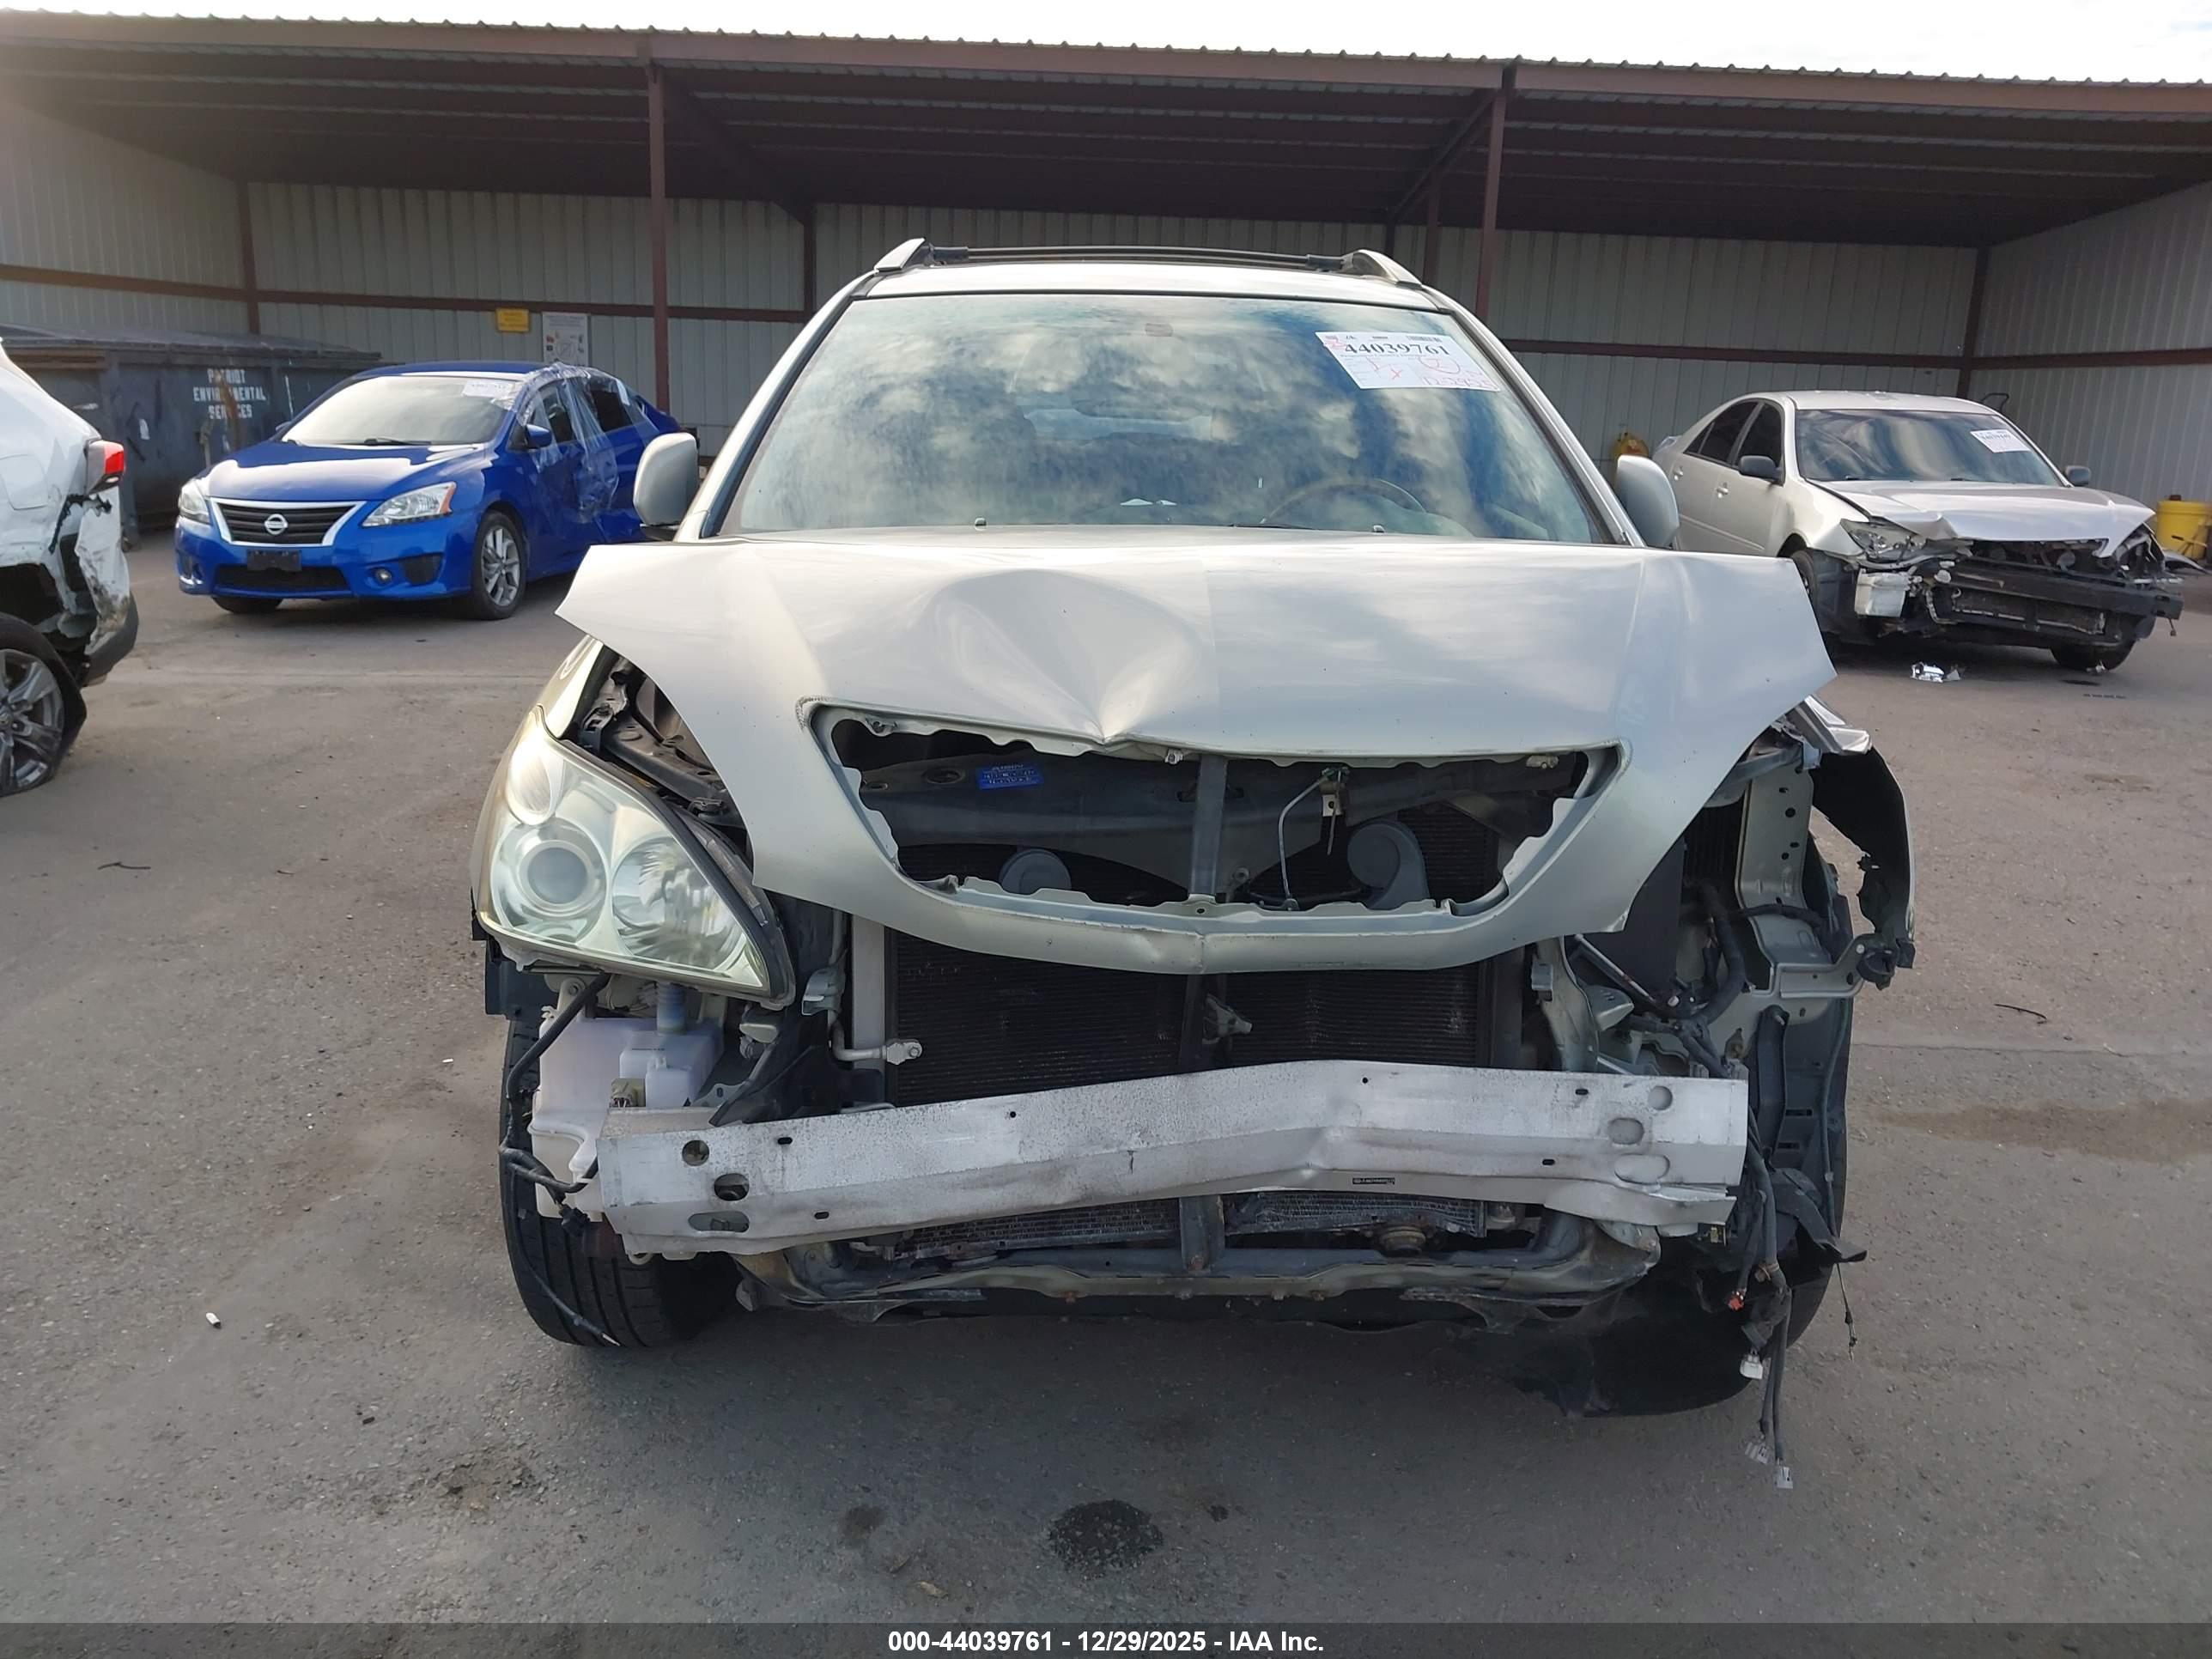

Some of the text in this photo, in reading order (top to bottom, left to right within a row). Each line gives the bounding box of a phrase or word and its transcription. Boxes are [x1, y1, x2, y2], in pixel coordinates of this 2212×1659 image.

[1345, 343, 1450, 356] 44039761
[193, 386, 266, 402] ENVIRMENTAL
[209, 404, 252, 420] SERCES
